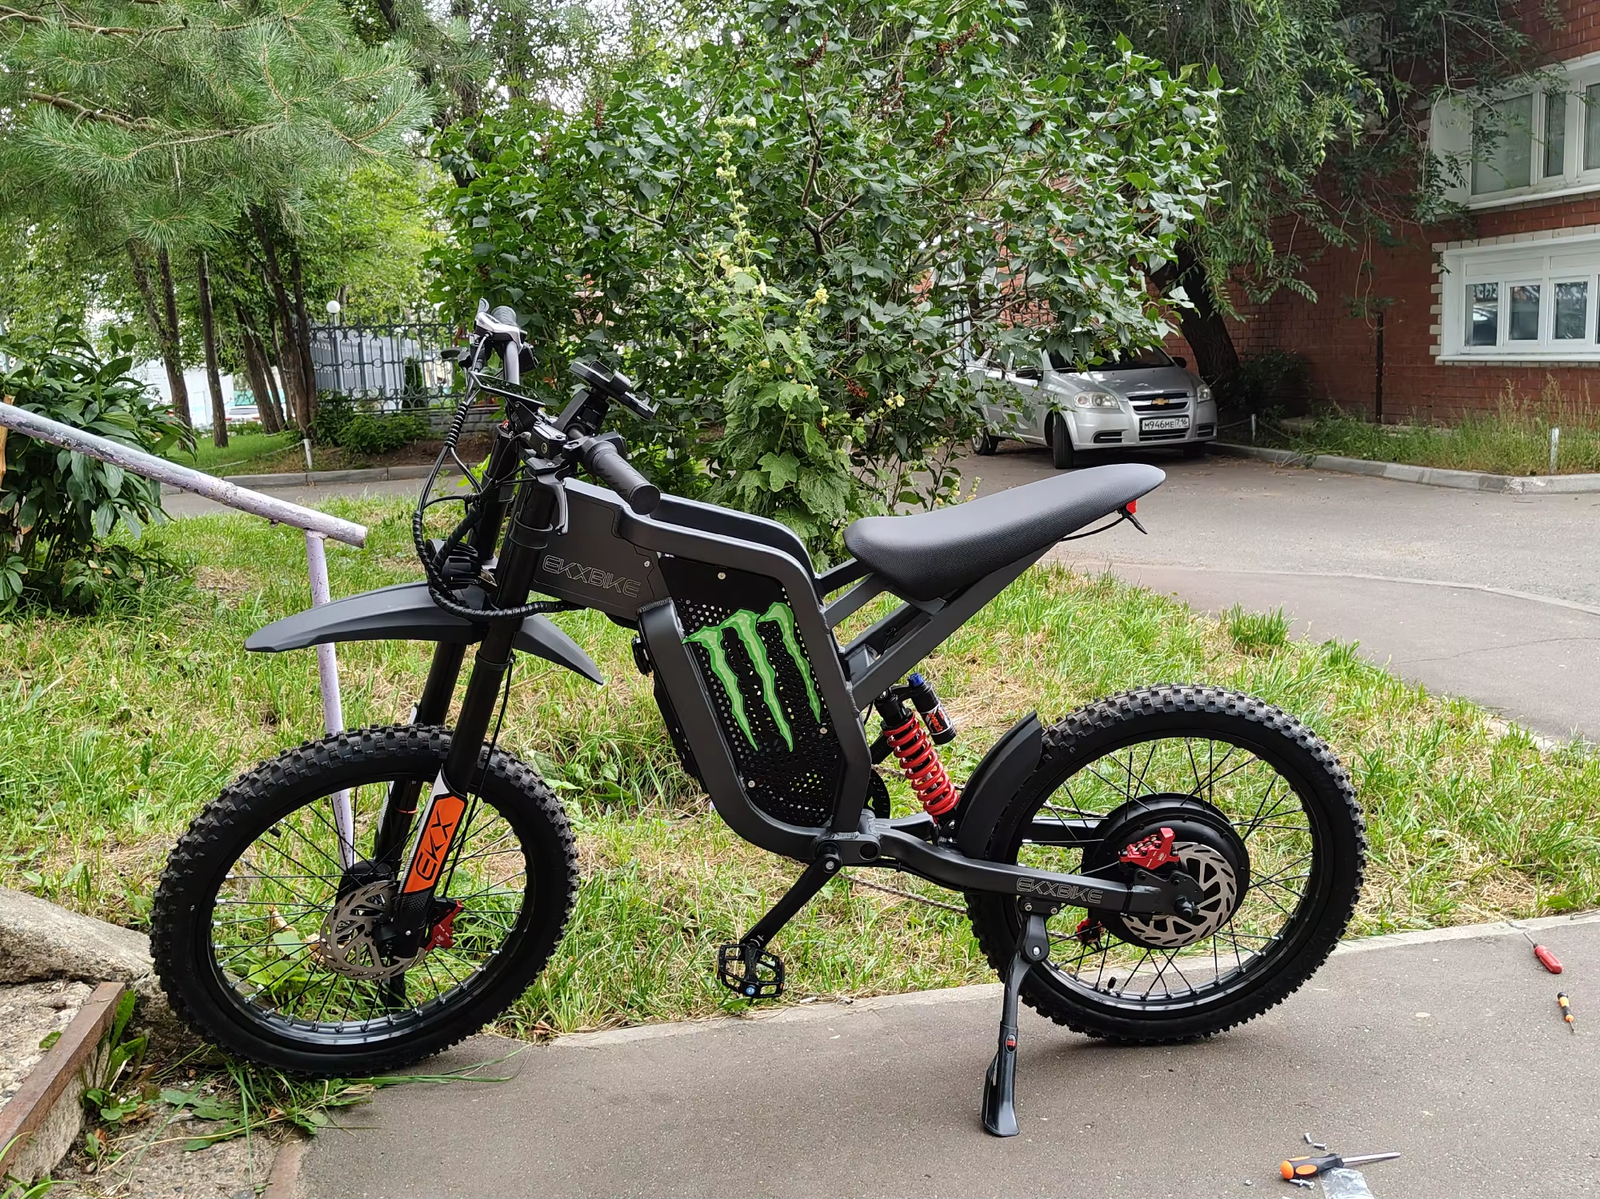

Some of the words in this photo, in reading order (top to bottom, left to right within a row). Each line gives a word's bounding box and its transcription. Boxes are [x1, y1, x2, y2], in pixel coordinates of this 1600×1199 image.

[542, 554, 641, 598] EKXBIKE
[415, 809, 454, 881] EKX
[1016, 877, 1104, 904] EKXBIKE
